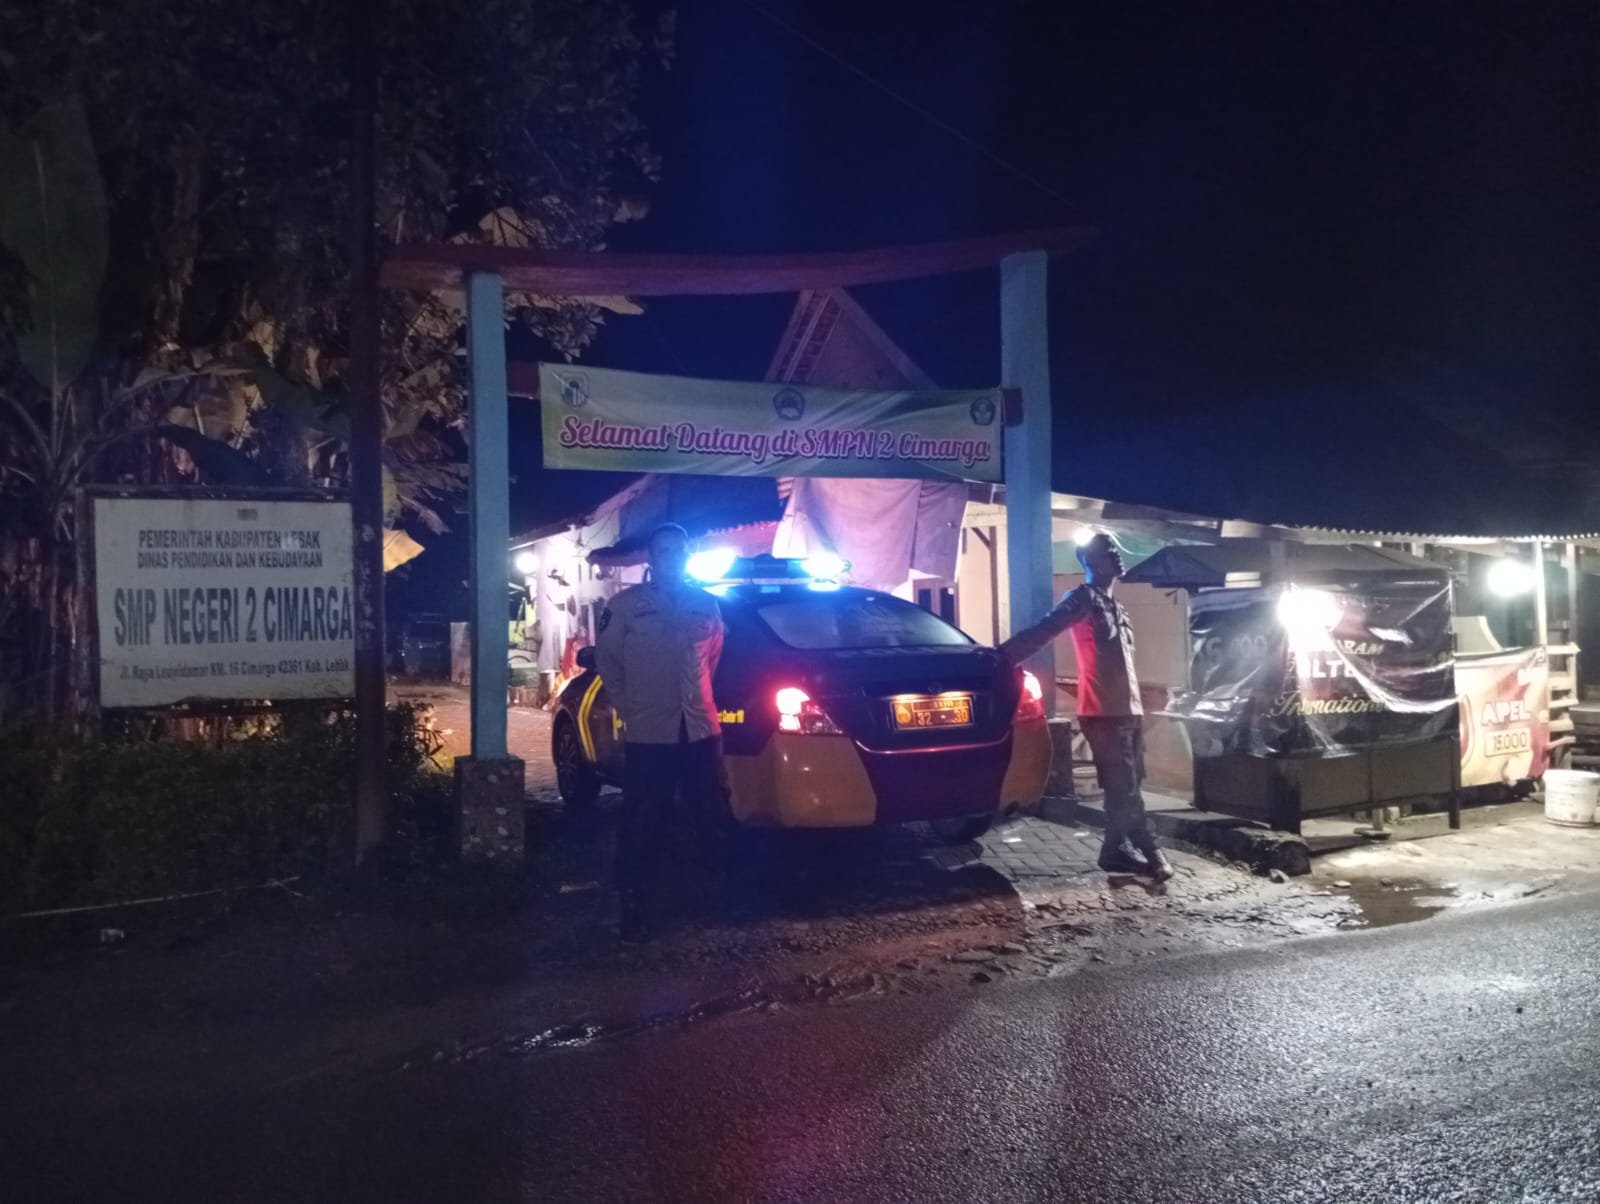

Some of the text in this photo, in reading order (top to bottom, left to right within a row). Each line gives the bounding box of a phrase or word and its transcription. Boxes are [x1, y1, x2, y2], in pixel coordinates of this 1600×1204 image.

[560, 415, 991, 467] Selamat Datang di SMPN 2 Cimarga
[138, 530, 213, 549] PEMERINTAH
[215, 530, 281, 549] KABUPATEN
[137, 551, 323, 569] DINAS PENDIDIKAN DAN KEBUDAYAAN
[114, 586, 353, 646] SMP NEGERI 2 CIMARGA
[1481, 700, 1531, 726] APEL
